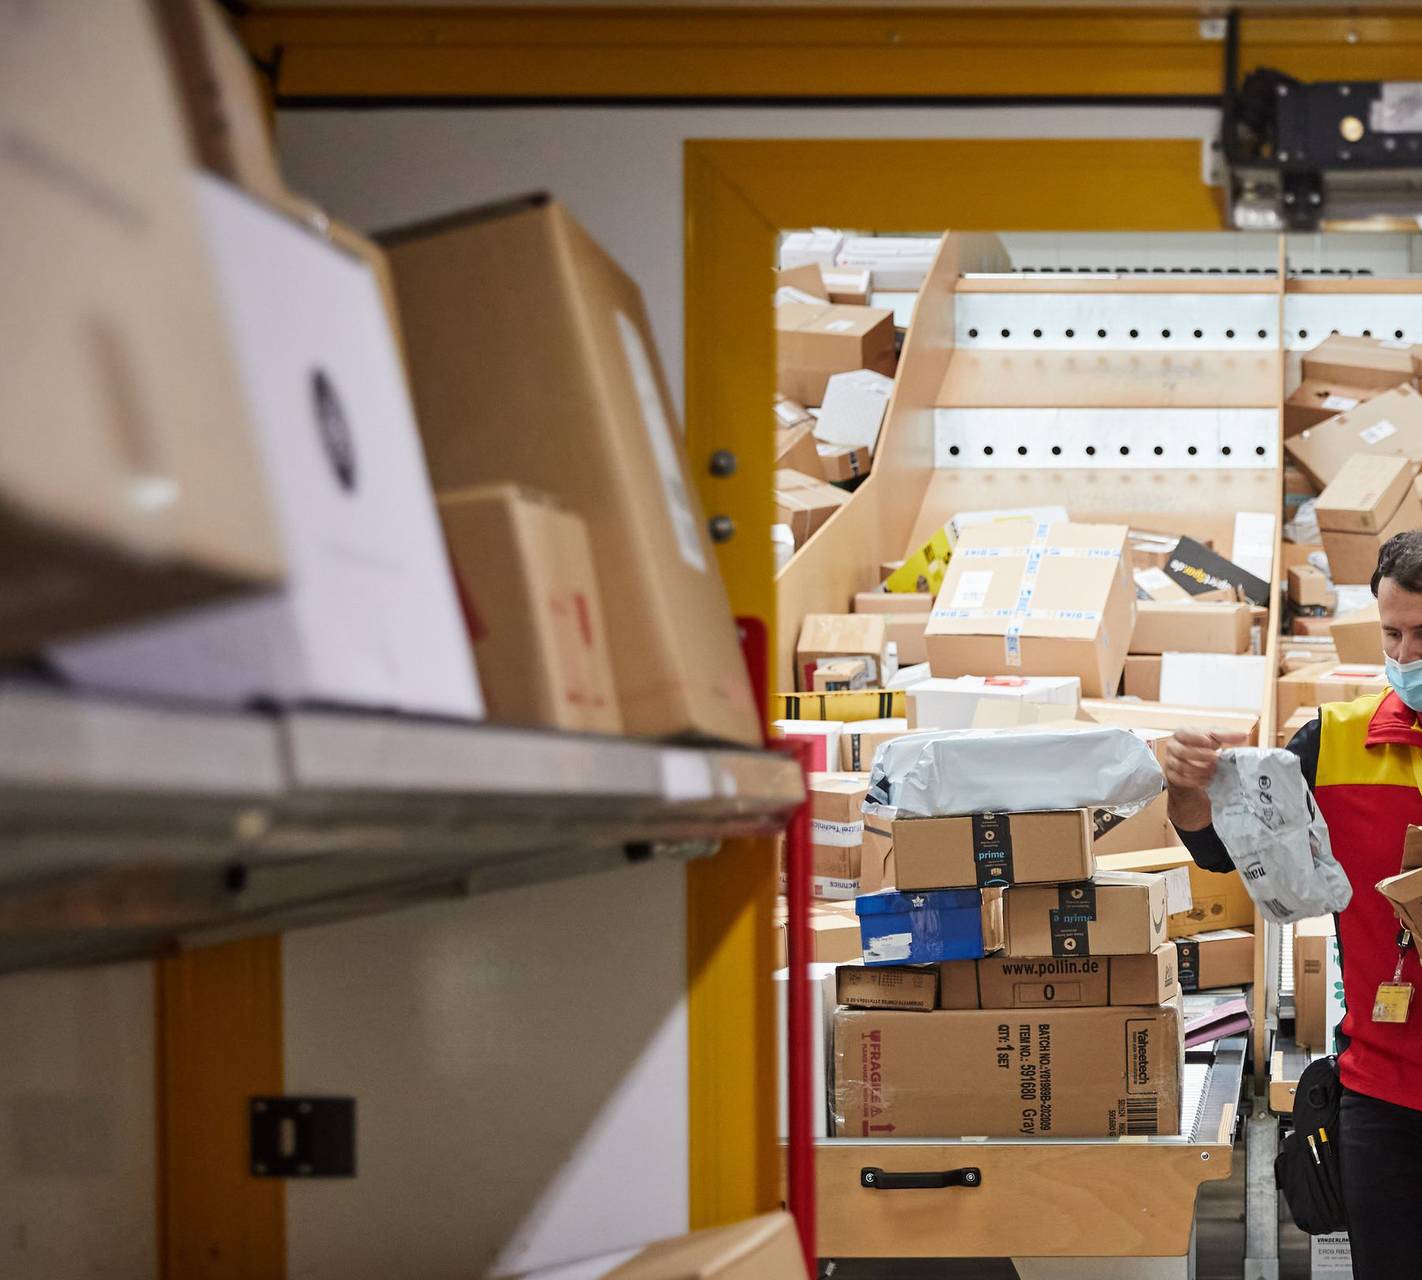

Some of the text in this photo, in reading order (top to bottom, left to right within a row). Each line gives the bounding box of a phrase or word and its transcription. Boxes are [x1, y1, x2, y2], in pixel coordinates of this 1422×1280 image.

[978, 850, 1005, 861] prime
[1002, 959, 1099, 977] www.pollin.de
[996, 1024, 1015, 1069] QTY: 1 SET
[1038, 1024, 1050, 1052] BATCH
[1137, 1028, 1150, 1085] Yaheetech
[870, 1043, 882, 1103] FRAGILE
[1019, 1024, 1038, 1134] ITEM NO.: 591680 Gray
